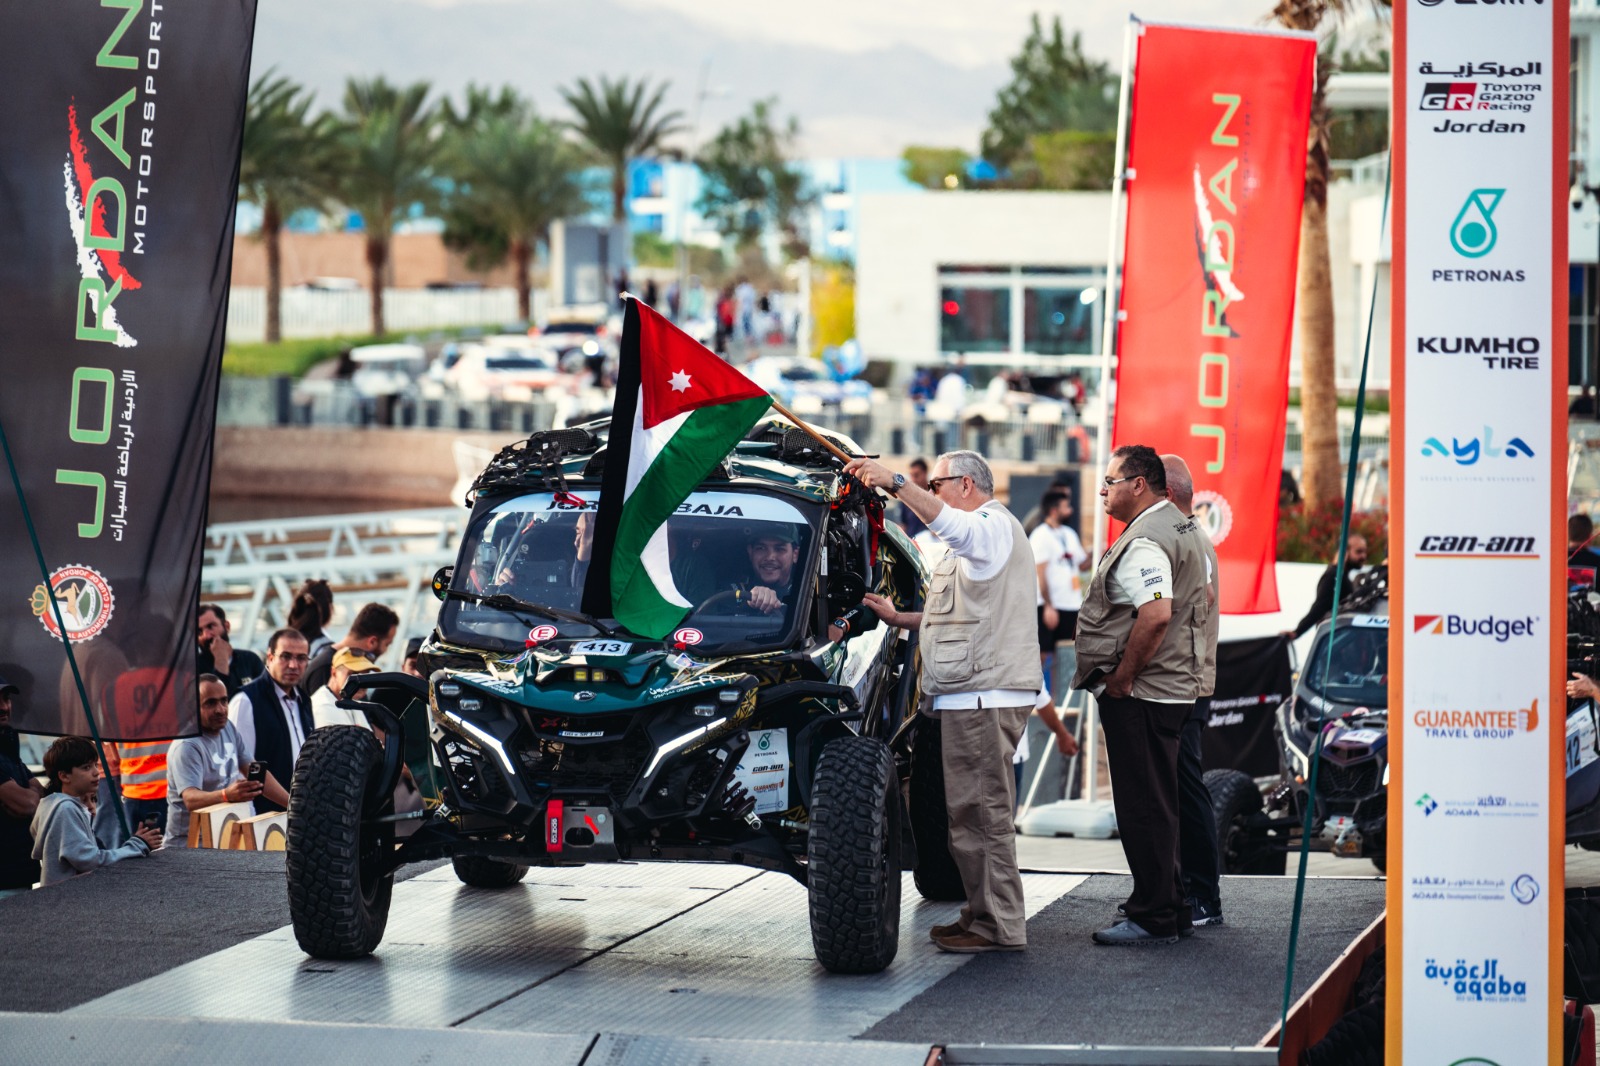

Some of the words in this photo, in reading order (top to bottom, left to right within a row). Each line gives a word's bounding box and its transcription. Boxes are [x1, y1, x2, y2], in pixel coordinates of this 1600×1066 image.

[1419, 62, 1542, 78] المركزية
[1481, 83, 1542, 92] TOYOTA
[1421, 92, 1474, 111] GR
[1479, 93, 1535, 101] GAZOO
[1477, 102, 1532, 112] Racing
[133, 0, 163, 254] MOTORSPORT
[1433, 119, 1526, 133] Jordan
[55, 0, 143, 538] JORDAN
[1432, 270, 1526, 282] PETRONAS
[1190, 93, 1241, 474] JORDAN
[1417, 337, 1540, 354] KUMHO
[1483, 357, 1540, 369] TIRE
[116, 424, 135, 477] لرياضة
[110, 480, 127, 541] السيارات
[675, 503, 744, 517] BAJA
[1420, 536, 1536, 553] can-am
[60, 569, 88, 578] JORDAN
[89, 573, 99, 583] OF
[97, 582, 110, 602] CLUB
[77, 603, 110, 638] AUTOMOBILE
[1447, 615, 1535, 642] Budget
[53, 627, 76, 638] ROAL
[583, 643, 622, 652] 413
[1413, 709, 1517, 728] GUARANTEE
[1425, 728, 1469, 739] TRAVEL
[1473, 729, 1514, 739] GROUP
[1566, 735, 1580, 770] 12
[752, 764, 784, 772] can-am
[1454, 974, 1527, 1000] aqaba
